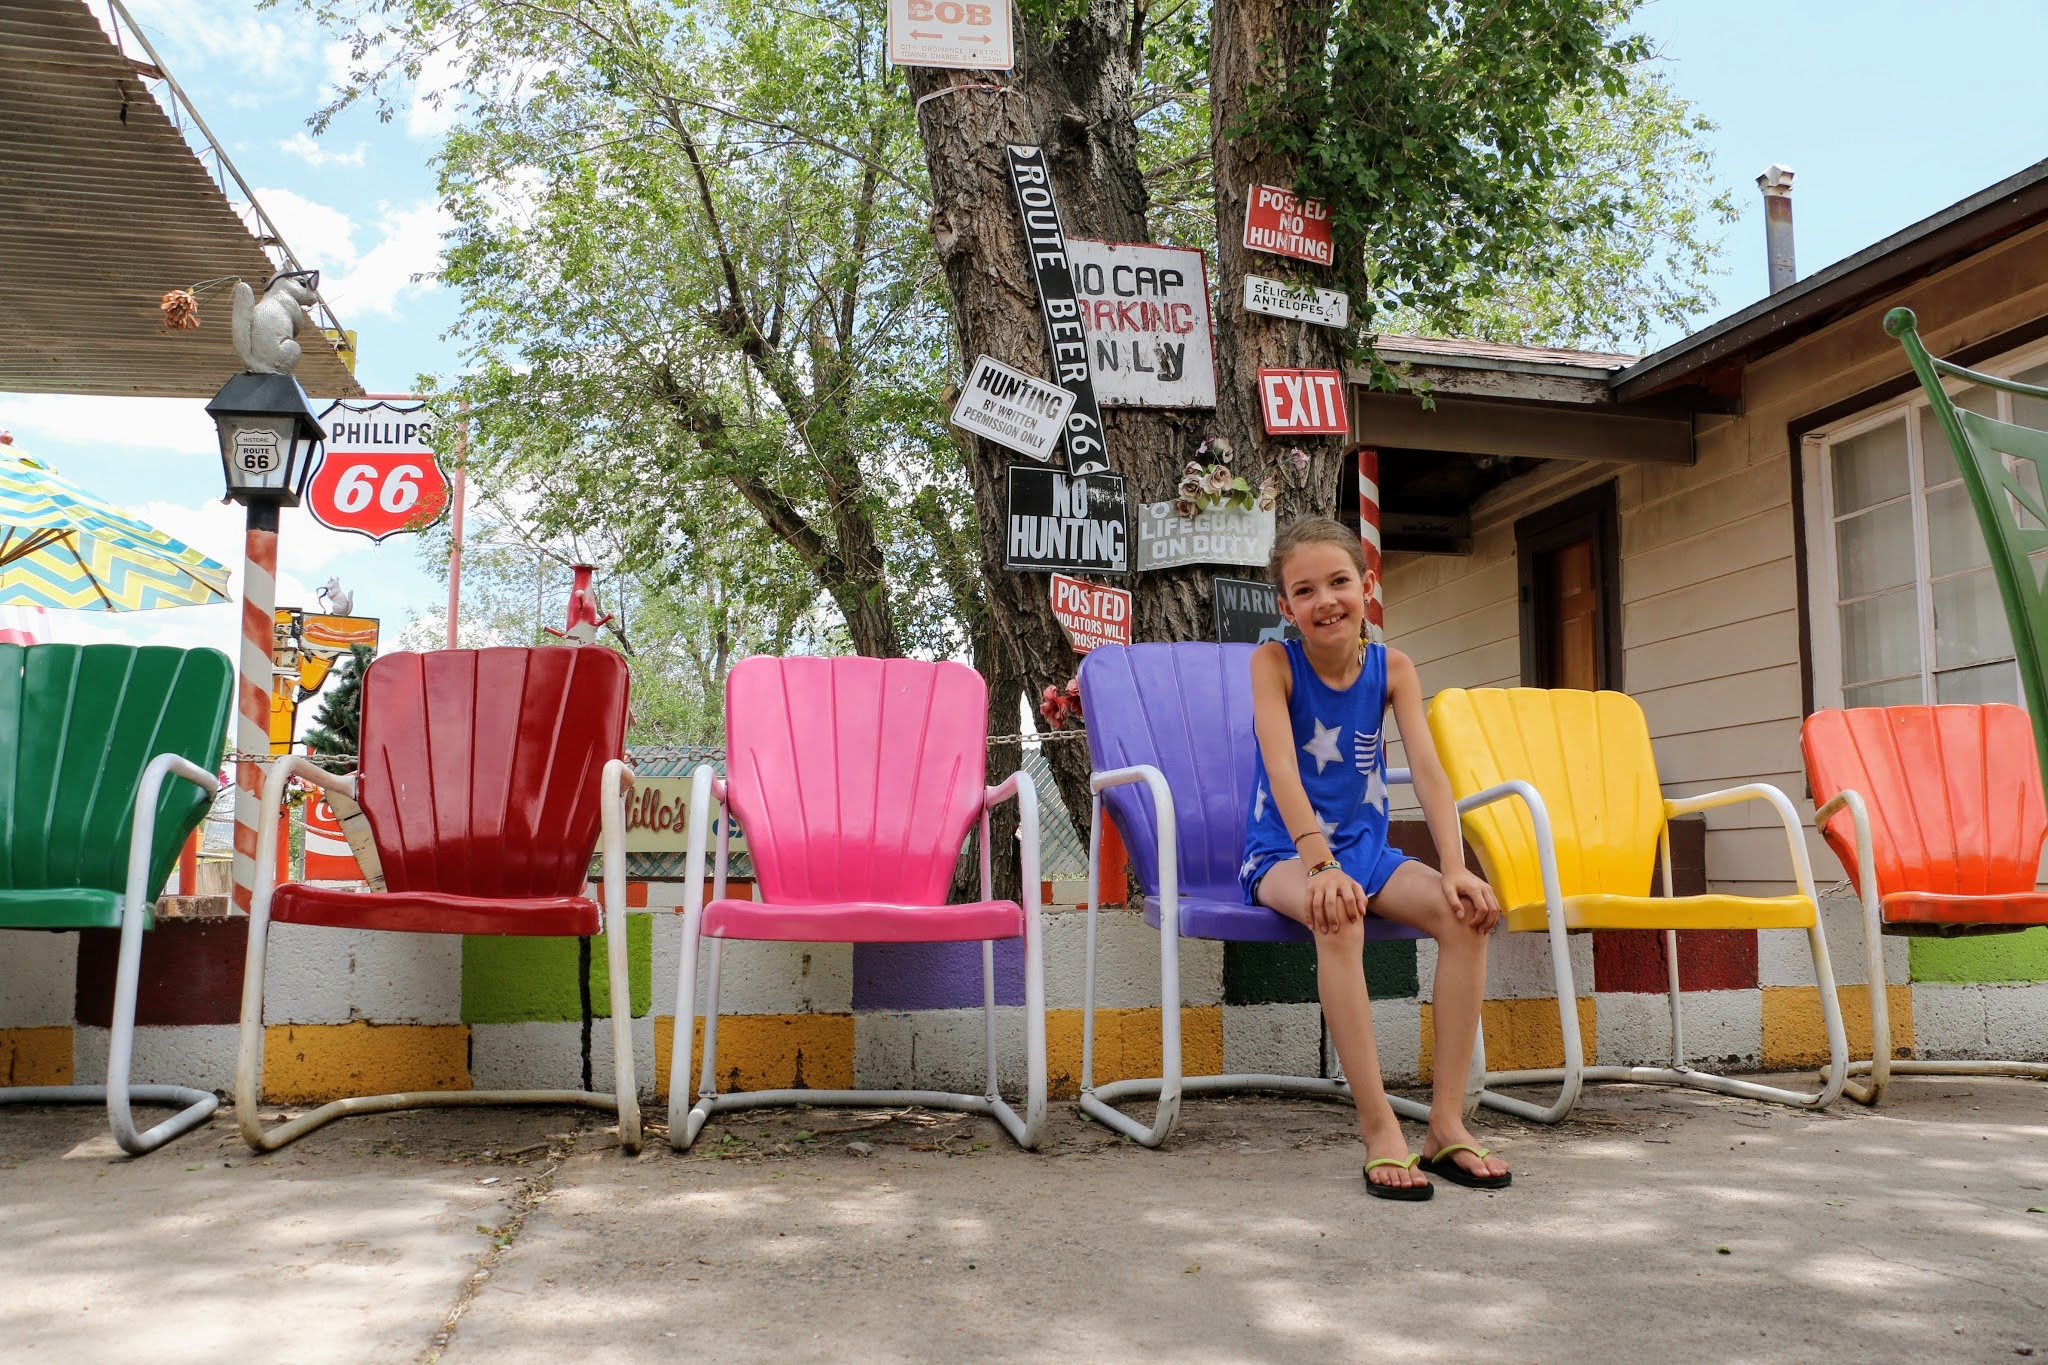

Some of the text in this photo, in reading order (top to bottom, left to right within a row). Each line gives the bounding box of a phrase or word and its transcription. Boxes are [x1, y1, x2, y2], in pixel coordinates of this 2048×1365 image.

[907, 0, 992, 26] BOB
[900, 43, 917, 51] CITY
[922, 45, 964, 54] ORDINANCE
[901, 51, 927, 59] TOWING
[931, 52, 959, 60] CHARGE
[1258, 189, 1327, 221] POSTED
[1279, 213, 1304, 235] NO
[1250, 226, 1328, 261] HUNTING
[1112, 265, 1184, 297] CAP
[1254, 284, 1320, 305] SELIGMAN
[1014, 164, 1102, 456] ROUTE BEER 66
[1079, 299, 1194, 334] ARKING
[1252, 294, 1324, 315] ANTELOPES
[1096, 339, 1185, 382] NLY
[976, 365, 1063, 421] HUNTING
[1263, 376, 1337, 427] EXIT
[963, 406, 1046, 449] PERMISSION ONLY
[982, 399, 1039, 431] BY WRITTEN
[331, 422, 432, 445] PHILLIPS
[244, 454, 269, 469] 66
[333, 464, 424, 514] 66
[1052, 473, 1089, 519] NO
[1010, 514, 1125, 563] HUNTING
[1141, 514, 1270, 541] LIFEGUAR
[1152, 535, 1259, 560] ON DUTY
[1057, 580, 1126, 622] POSTED
[1221, 585, 1283, 616] WARN
[1055, 610, 1126, 640] VIOLATORS WILL
